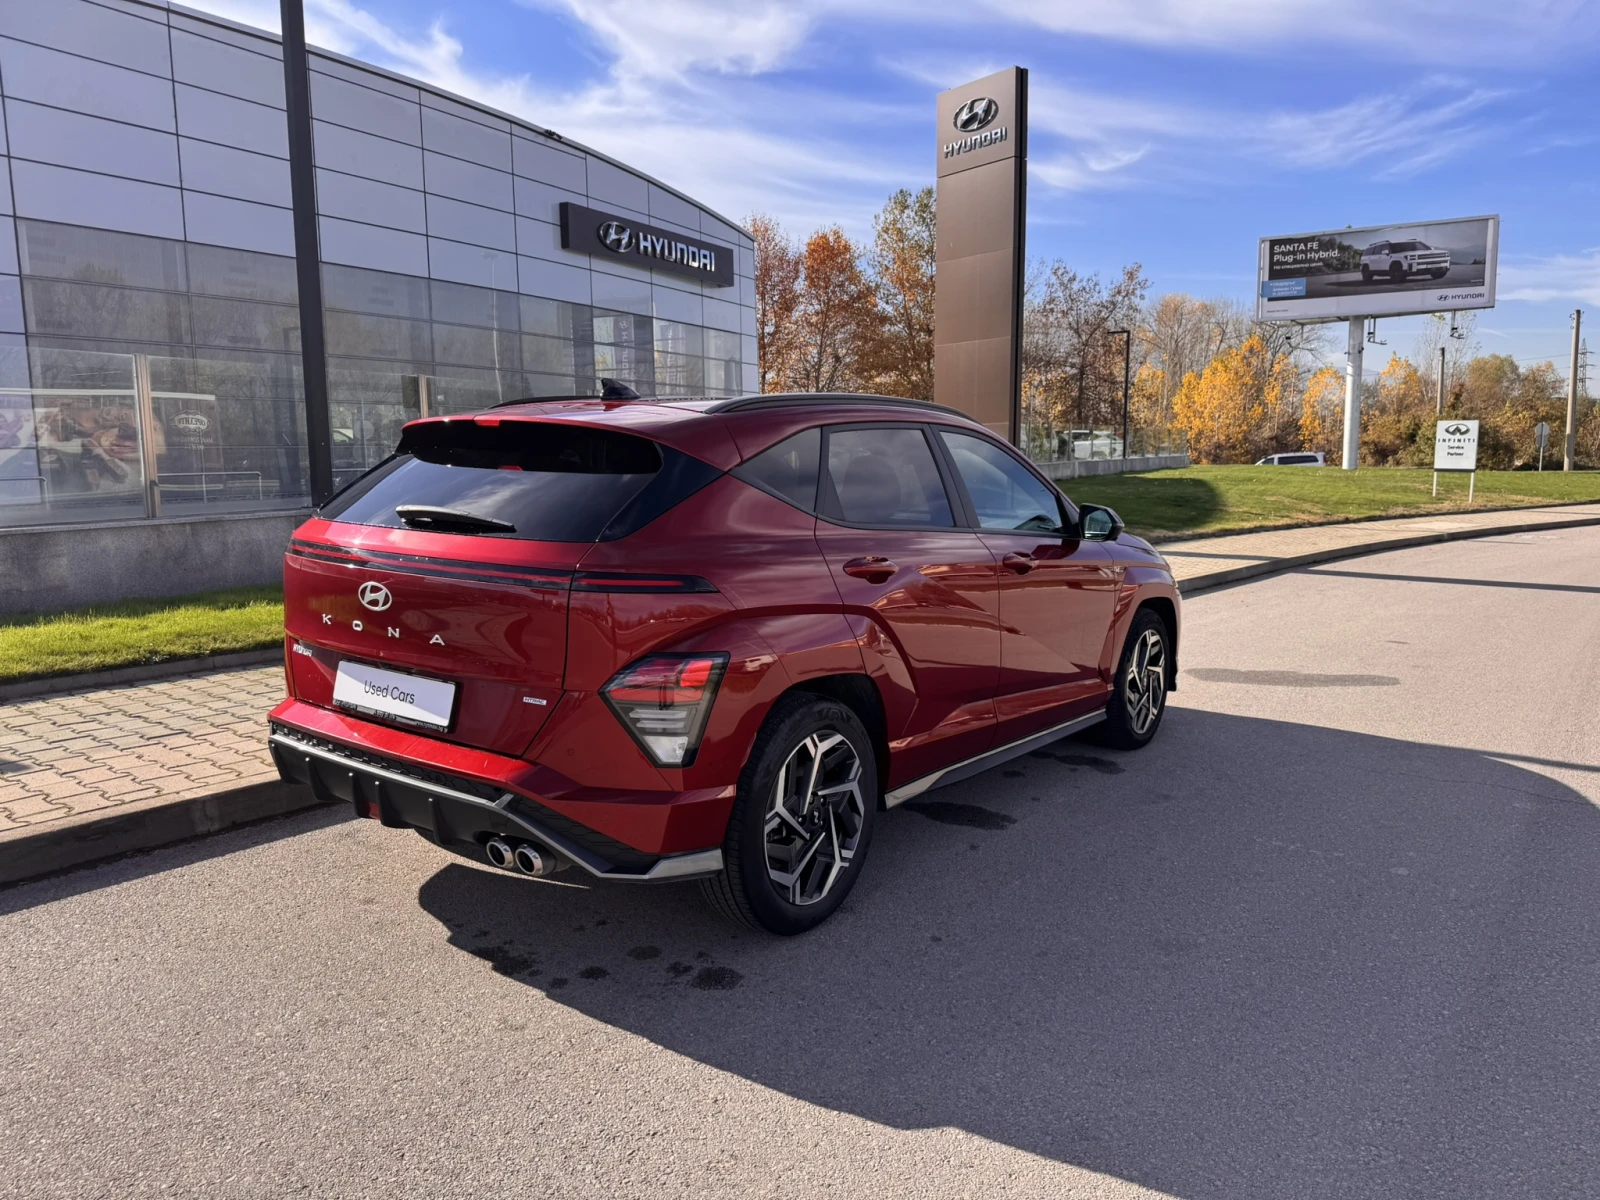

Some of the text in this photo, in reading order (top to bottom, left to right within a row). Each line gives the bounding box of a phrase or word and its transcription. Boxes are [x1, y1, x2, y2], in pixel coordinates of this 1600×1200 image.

[943, 126, 1008, 159] HYUNDAI
[639, 231, 716, 272] HYUNDAI
[1273, 241, 1319, 253] SANTA FE
[1273, 249, 1340, 263] Plug-in Hybrid.
[1451, 292, 1485, 300] HYUNDAI
[321, 613, 446, 646] KONA
[363, 679, 415, 704] Used Cars
